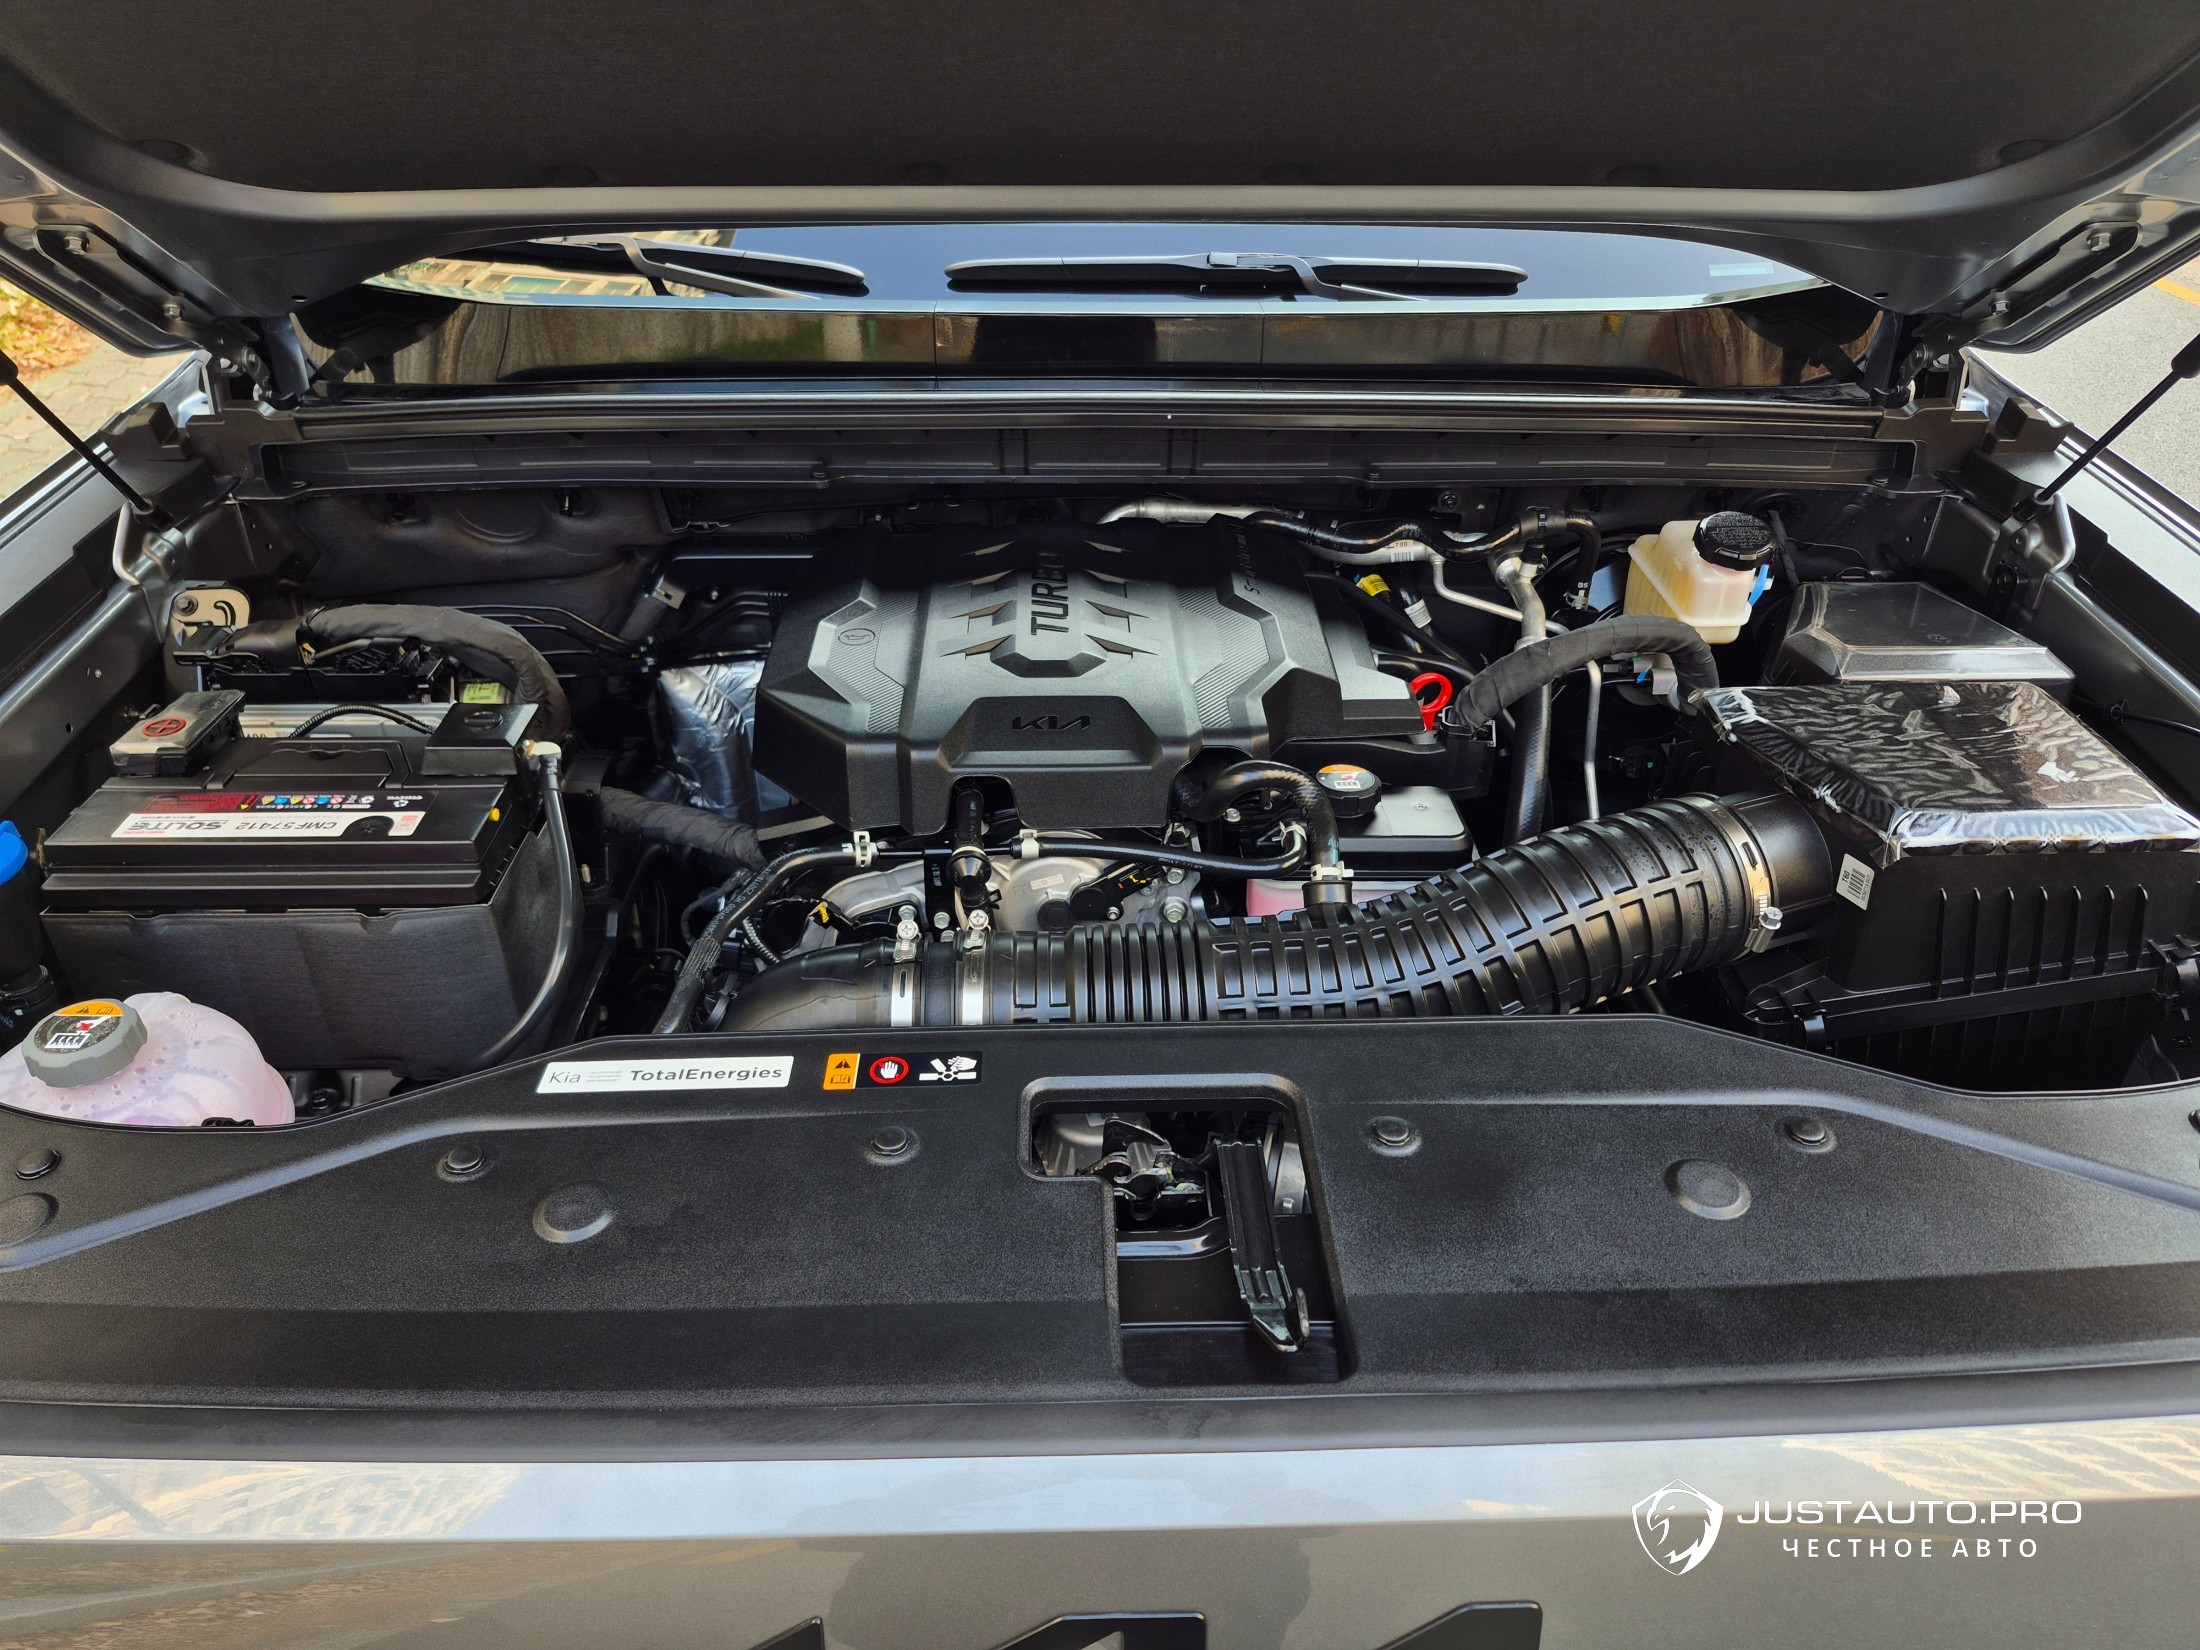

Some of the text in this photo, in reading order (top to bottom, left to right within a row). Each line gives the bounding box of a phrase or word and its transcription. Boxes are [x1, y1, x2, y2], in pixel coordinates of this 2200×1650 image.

[1031, 551, 1069, 636] TURBO
[1012, 715, 1091, 731] KIA
[128, 821, 223, 832] SOLITE
[549, 1071, 581, 1084] Kia
[630, 1067, 783, 1082] TotalEnergies
